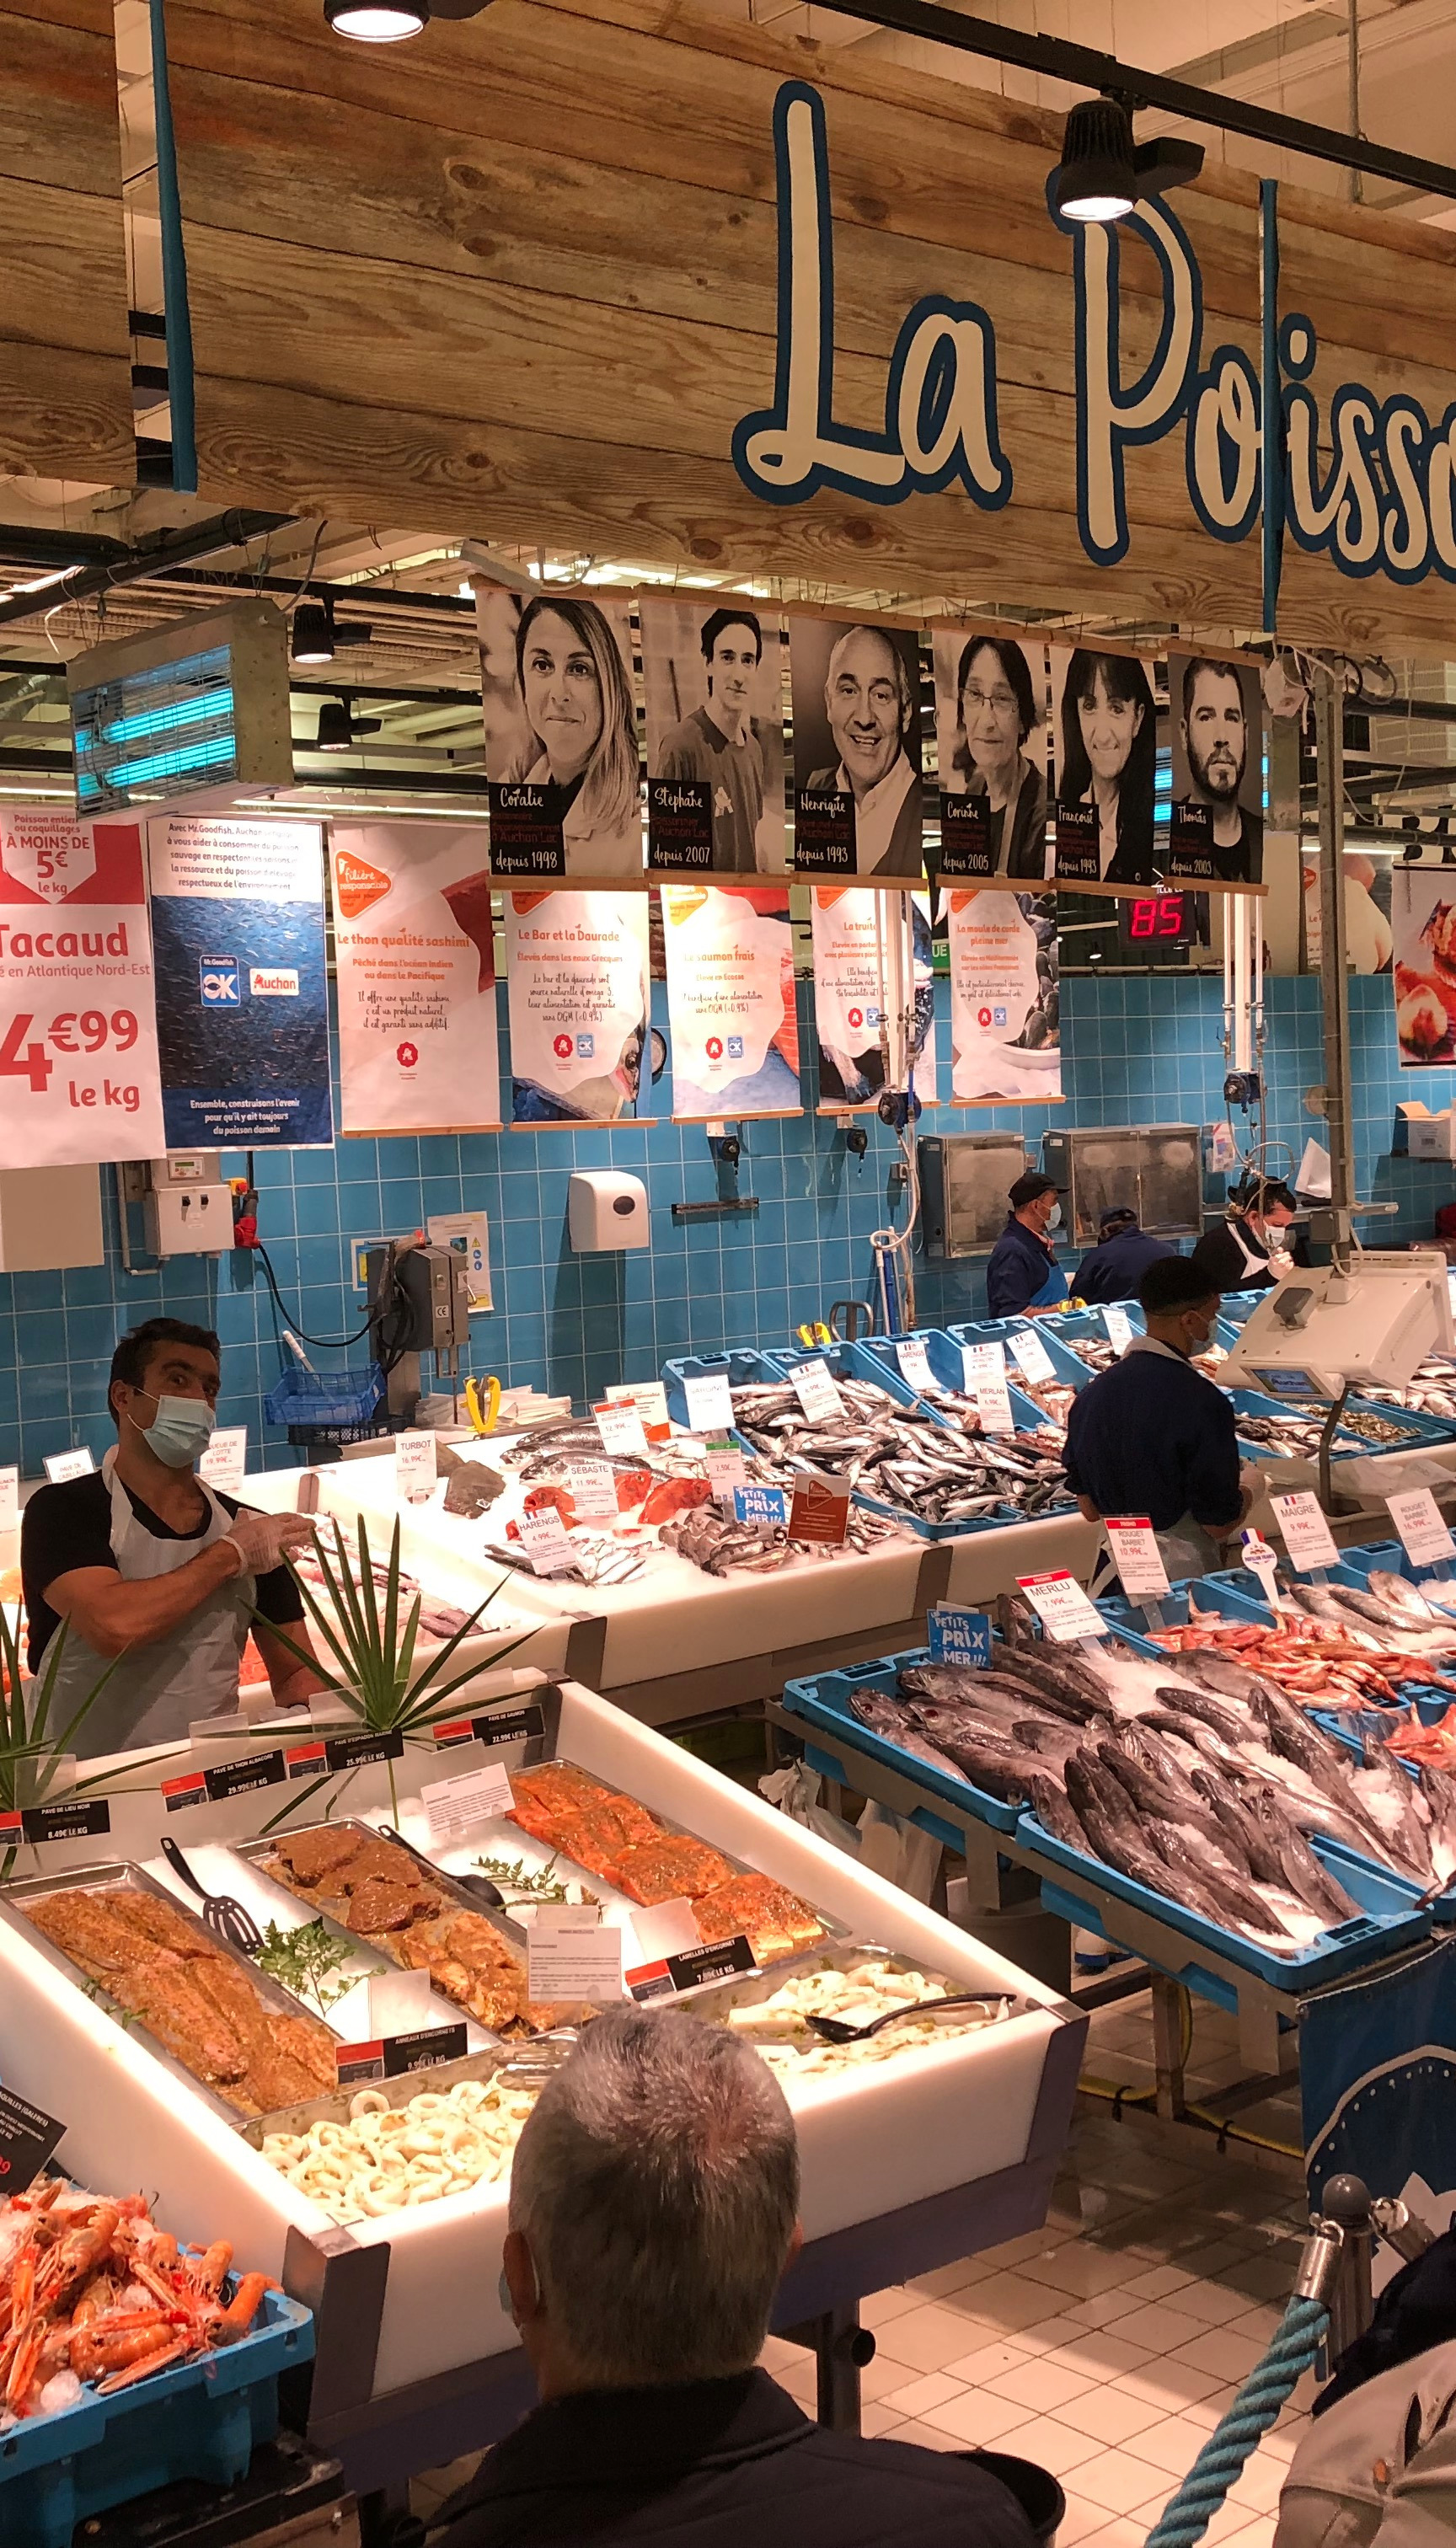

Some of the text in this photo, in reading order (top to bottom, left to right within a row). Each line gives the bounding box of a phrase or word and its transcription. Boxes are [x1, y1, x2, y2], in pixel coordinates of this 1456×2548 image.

[731, 80, 1012, 511] La
[500, 786, 543, 807] Coralie
[655, 786, 704, 813] Stéphane
[800, 792, 846, 818] Henrique
[948, 801, 979, 819] Corinne
[14, 815, 48, 823] Poisson
[1177, 805, 1207, 824] Thomas
[28, 825, 80, 834] coquillages
[169, 823, 186, 832] Avec
[7, 832, 90, 849] À MOINS DE
[193, 838, 211, 846] aider
[213, 838, 217, 847] à
[170, 852, 201, 861] sauvage
[212, 854, 250, 863] respectant
[496, 848, 557, 873] depuis 1998
[654, 843, 710, 866] depuis 2007
[796, 843, 848, 865] depuis 1993
[37, 851, 68, 879] 5€
[171, 864, 179, 872] la
[944, 851, 988, 873] depuis 2005
[1058, 854, 1079, 875] depuis
[1171, 856, 1192, 876] depuis
[345, 868, 375, 881] filière
[38, 881, 67, 896] le kg
[179, 880, 233, 888] respectueux de
[1131, 897, 1183, 938] 85
[843, 922, 854, 931] La
[967, 924, 990, 933] moule
[992, 924, 1000, 933] de
[338, 933, 469, 948] Le thon qualité sashimi
[518, 929, 619, 941] Le Bar et la Daurade
[971, 937, 993, 946] pleine
[735, 950, 755, 961] frais
[8, 964, 150, 978] en Atlantique Nord-Est
[408, 972, 445, 981] Pacifique
[254, 974, 296, 989] Auchan
[533, 972, 596, 984] Le bar et la daurade
[203, 974, 238, 999] OK
[551, 986, 577, 995] naturelle
[367, 991, 383, 1004] offre
[543, 998, 581, 1008] alimentation
[393, 1004, 416, 1018] produit
[557, 1011, 573, 1022] OGM
[371, 1018, 379, 1028] est
[69, 1079, 139, 1112] le kg
[190, 1098, 300, 1109] Ensemble, construisons l'avenir
[205, 1111, 288, 1123] pour qu'il y ait toujours
[213, 1125, 280, 1136] du poisson demain
[400, 1440, 431, 1450] TURBOT
[571, 1465, 608, 1475] SEBASTE
[739, 1490, 767, 1500] PETITS
[745, 1499, 779, 1512] PRIX
[1281, 1504, 1316, 1518] MAIGRE
[1400, 1502, 1426, 1512] ROUGET
[519, 1516, 559, 1531] HARENGS
[746, 1512, 768, 1523] MER
[1030, 1582, 1070, 1597] MERLU
[934, 1616, 969, 1630] PETITS
[942, 1630, 984, 1649] PRIX
[944, 1651, 971, 1665] MER
[376, 1752, 385, 1760] KG
[259, 1777, 267, 1785] KG
[47, 1830, 67, 1839] 8.49€
[705, 1940, 735, 1953] D'ENCORNET
[716, 1964, 735, 1977] LE KG
[436, 2054, 445, 2064] KG
[5, 2132, 13, 2140] KG
